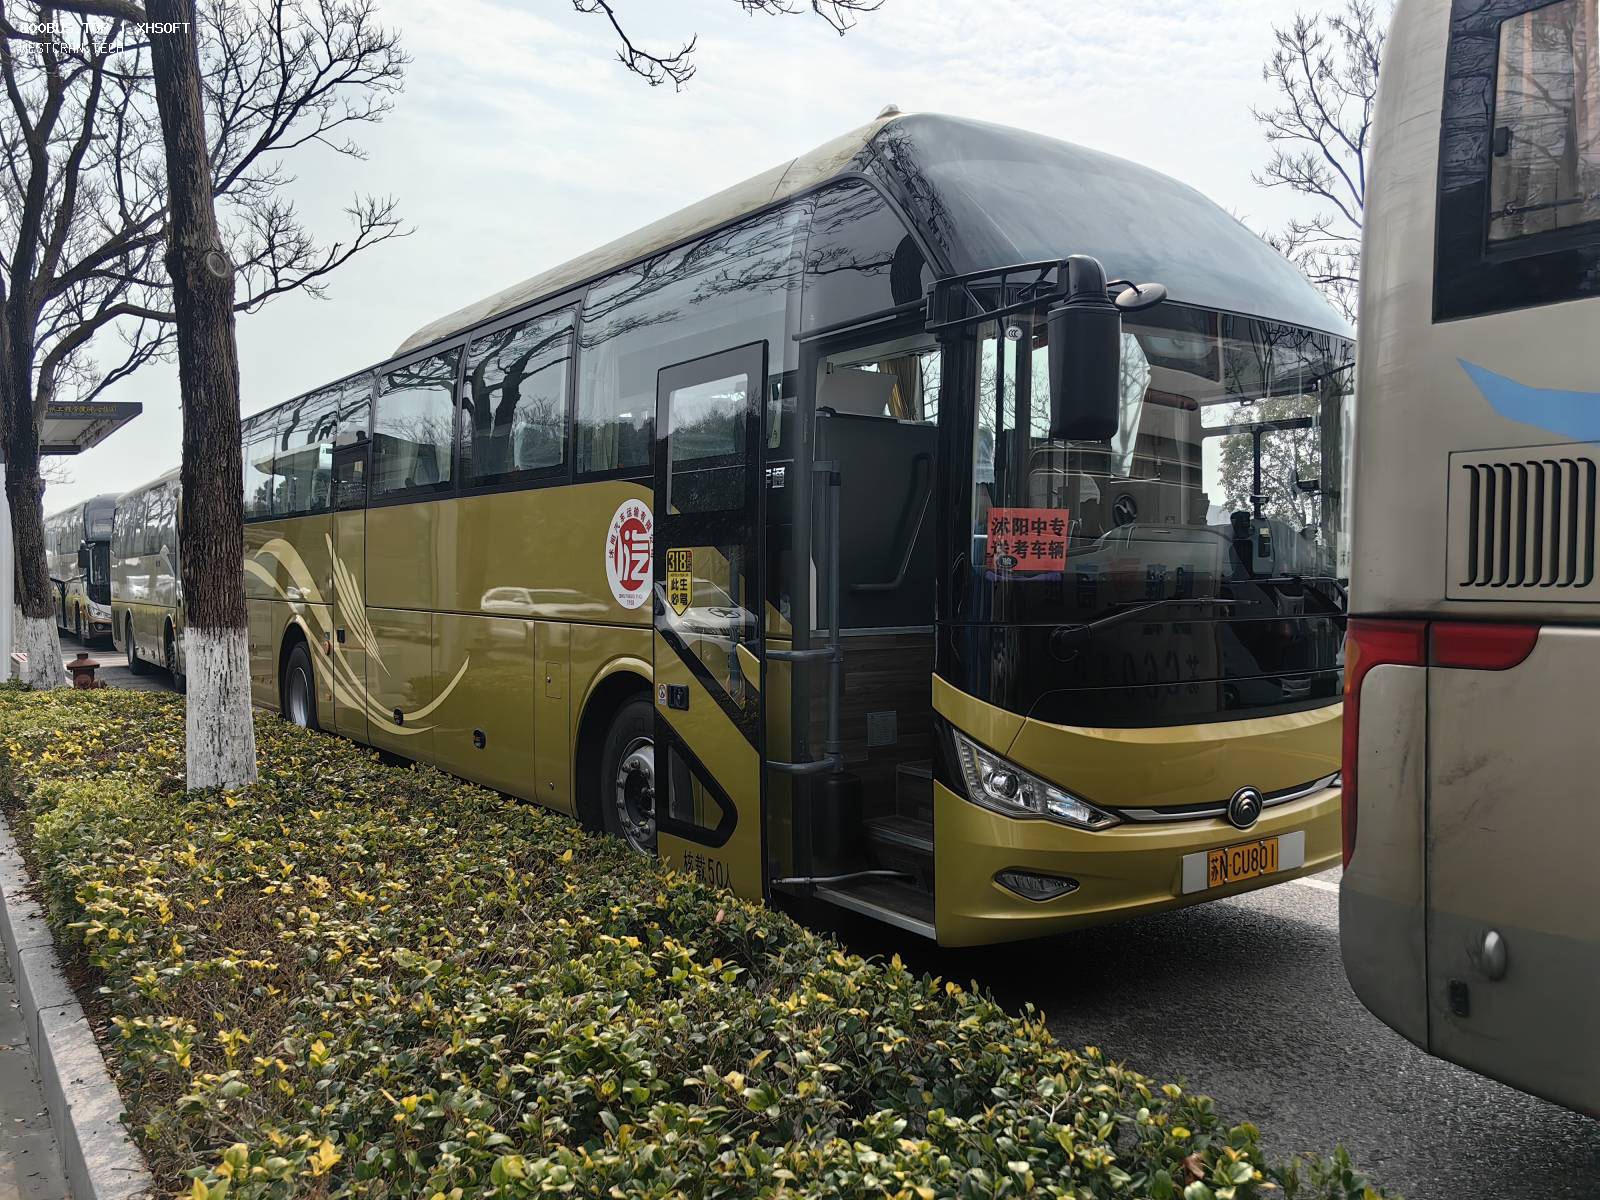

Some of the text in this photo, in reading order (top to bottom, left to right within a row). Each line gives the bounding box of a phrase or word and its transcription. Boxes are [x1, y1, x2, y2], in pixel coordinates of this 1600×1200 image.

[987, 539, 1065, 560] 送考车辆
[668, 551, 687, 572] 318
[671, 578, 689, 592] 此生
[671, 592, 689, 606] 必驾
